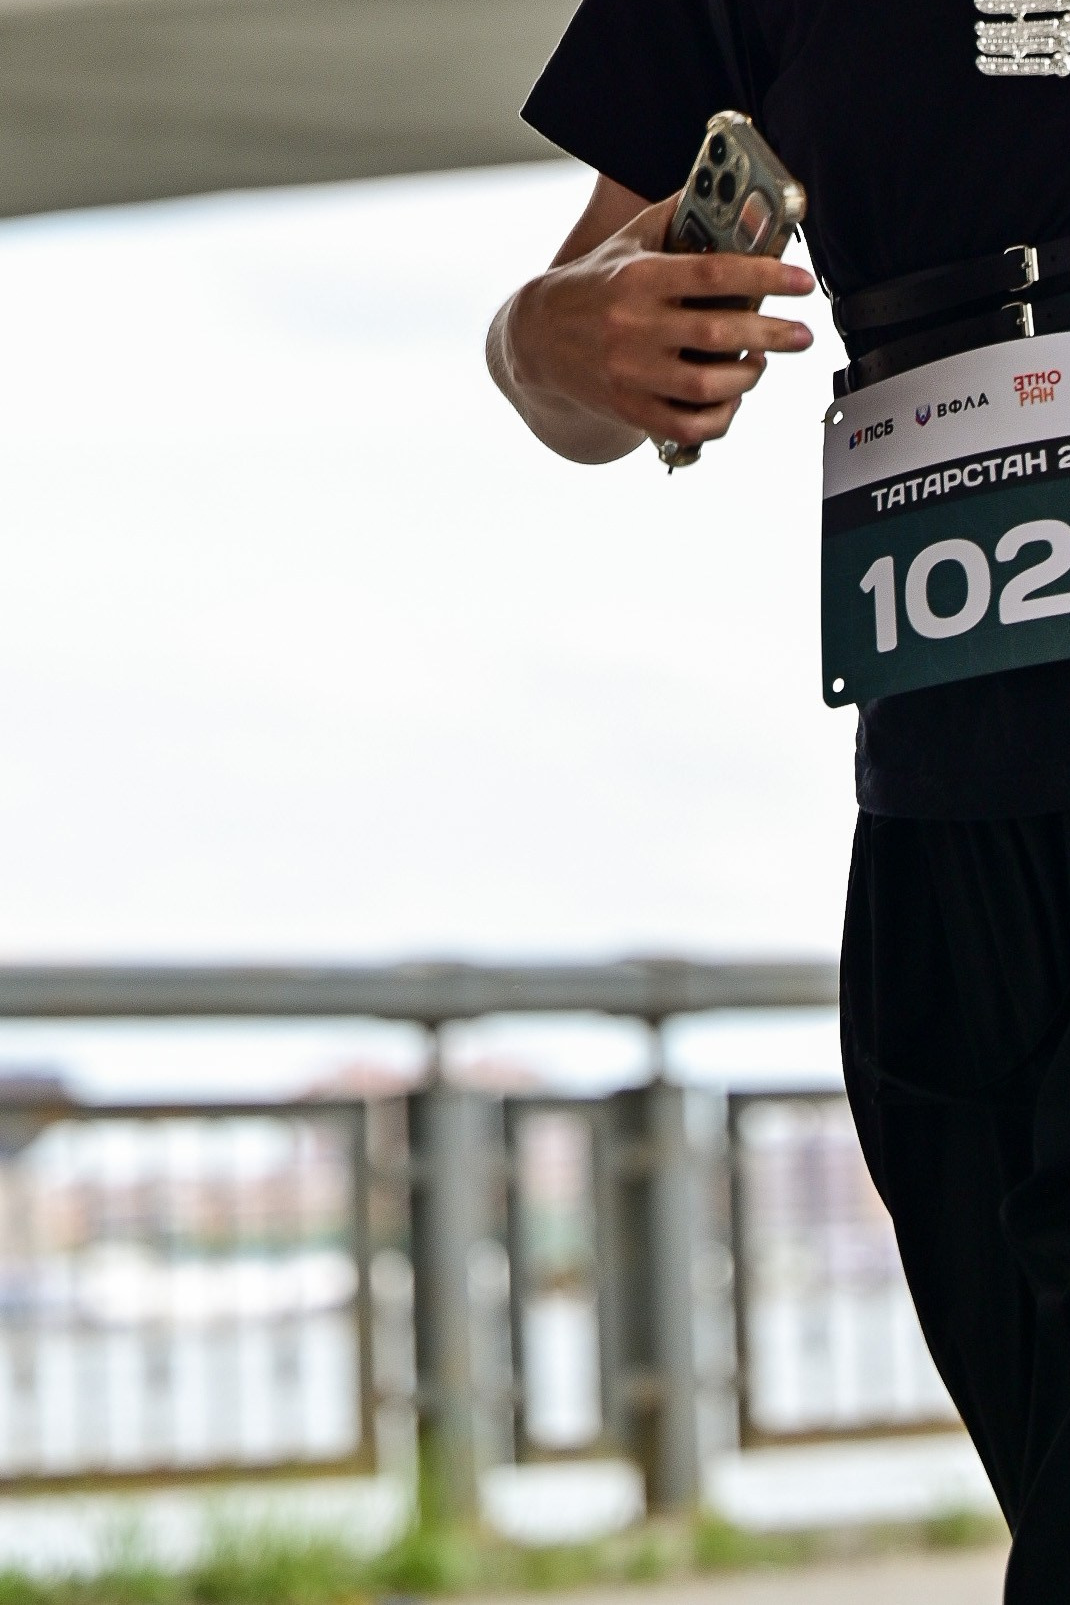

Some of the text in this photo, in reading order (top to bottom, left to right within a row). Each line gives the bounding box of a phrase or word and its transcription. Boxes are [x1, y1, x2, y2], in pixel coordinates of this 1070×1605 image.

[937, 393, 989, 419] ВФЛА
[864, 418, 894, 444] ПСБ
[871, 450, 1048, 512] ТАТАРСТАН
